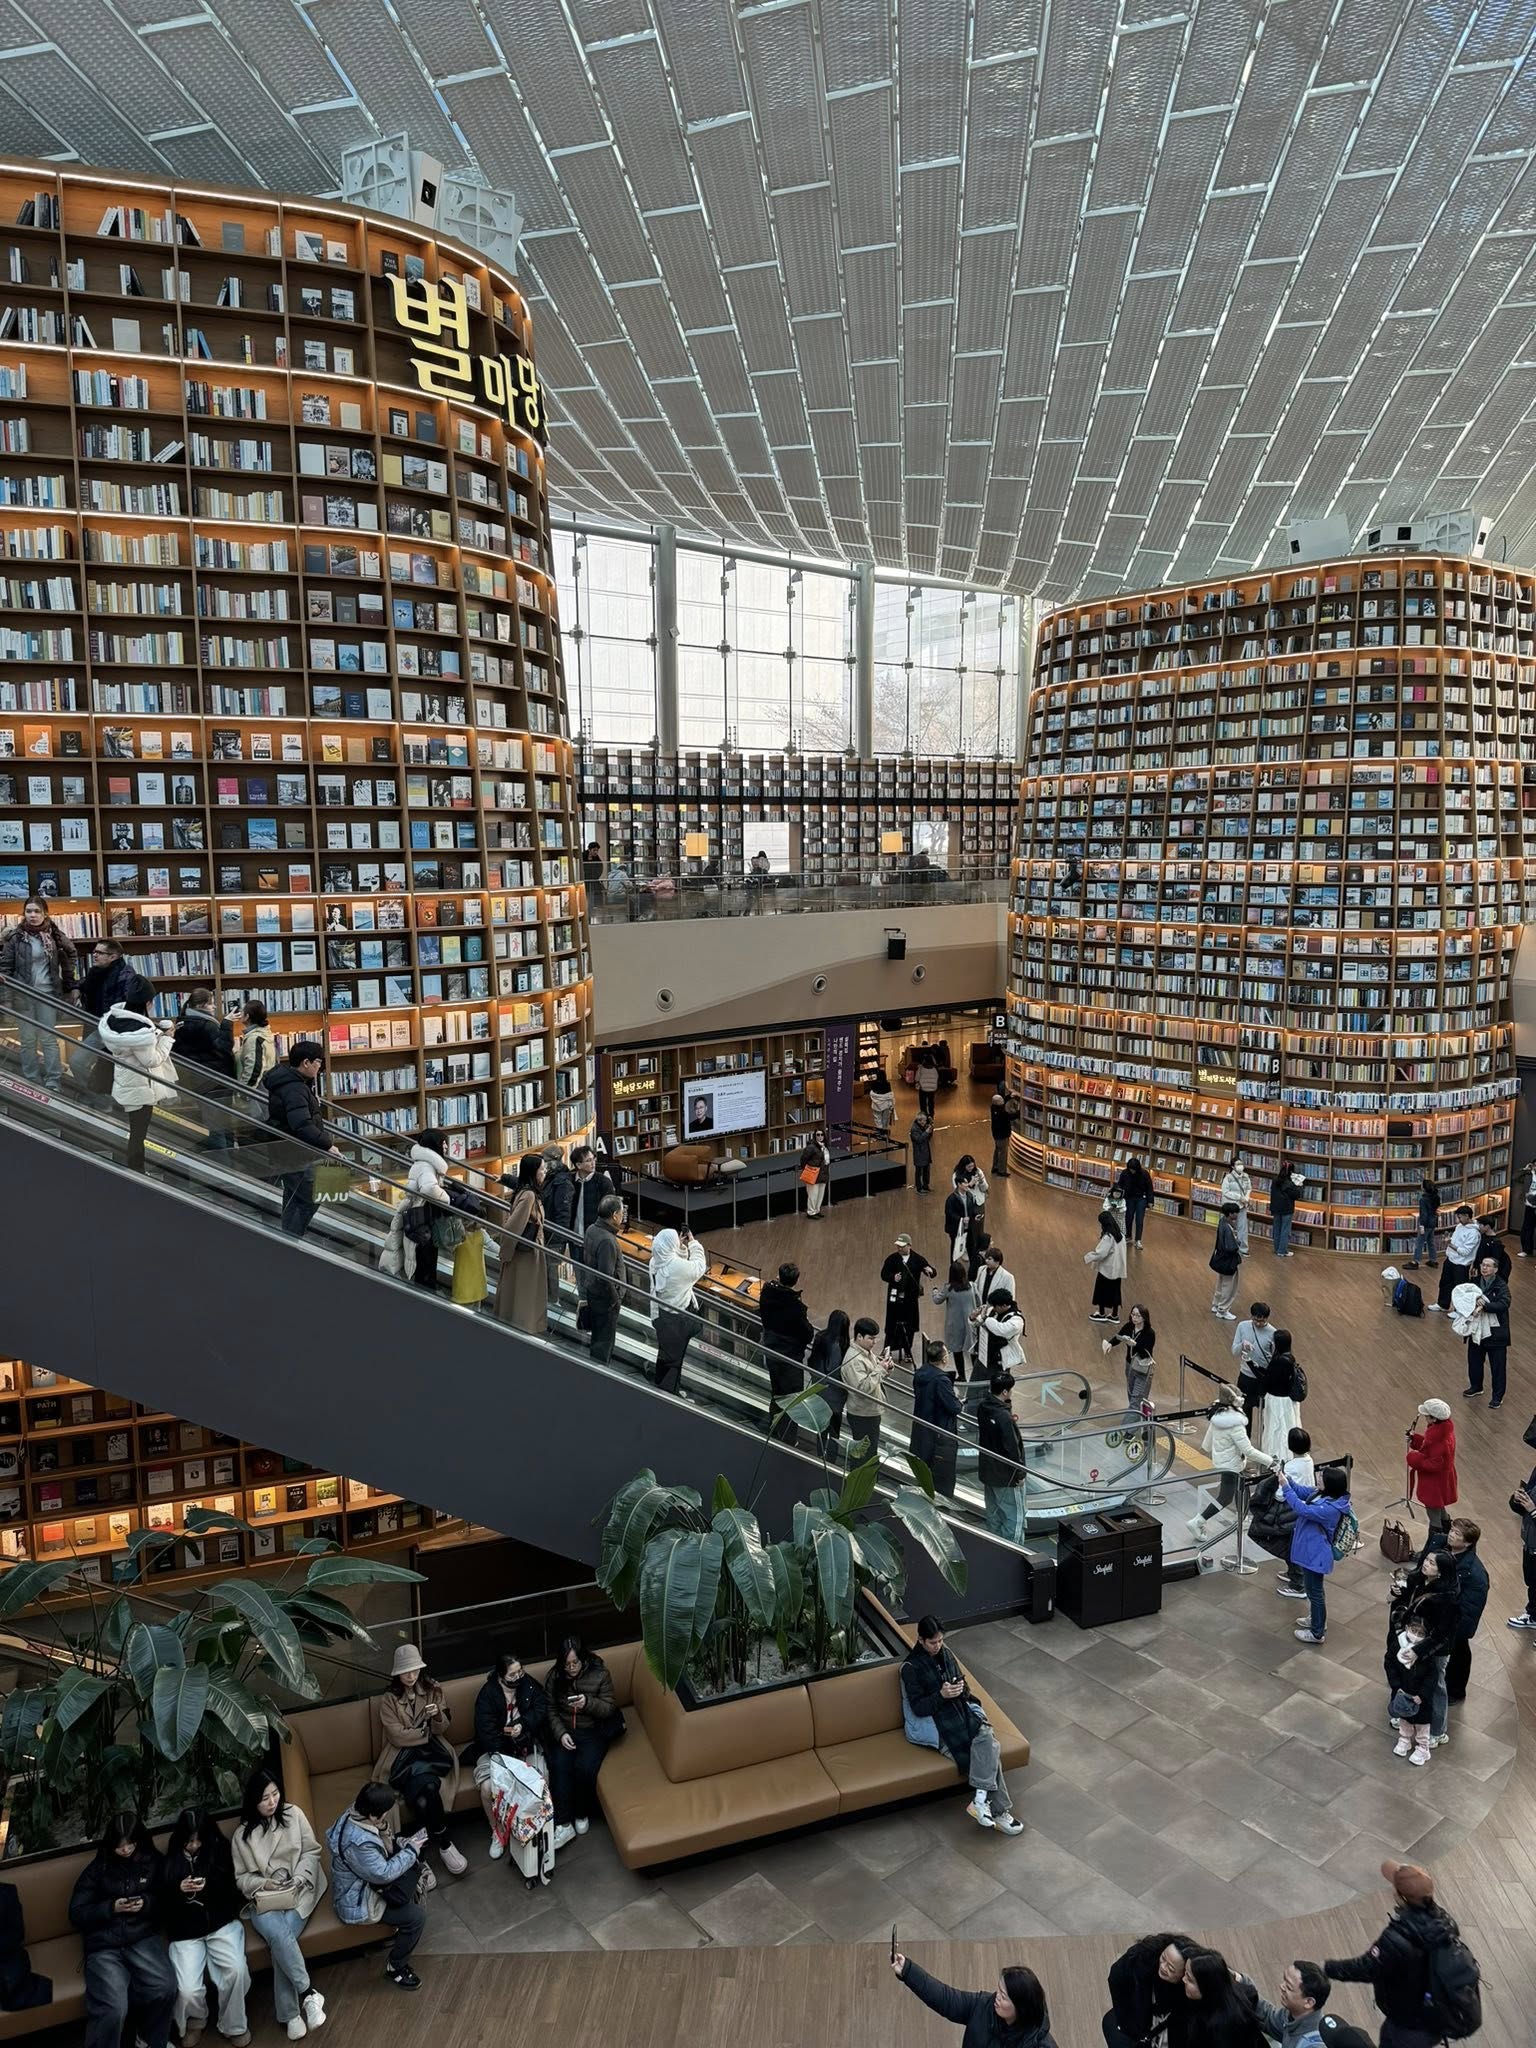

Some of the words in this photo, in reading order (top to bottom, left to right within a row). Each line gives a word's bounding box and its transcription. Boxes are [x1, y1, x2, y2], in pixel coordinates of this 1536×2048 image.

[996, 1015, 1005, 1028] B
[1272, 1059, 1280, 1074] B
[596, 1136, 608, 1155] A
[314, 1192, 349, 1203] JAJU
